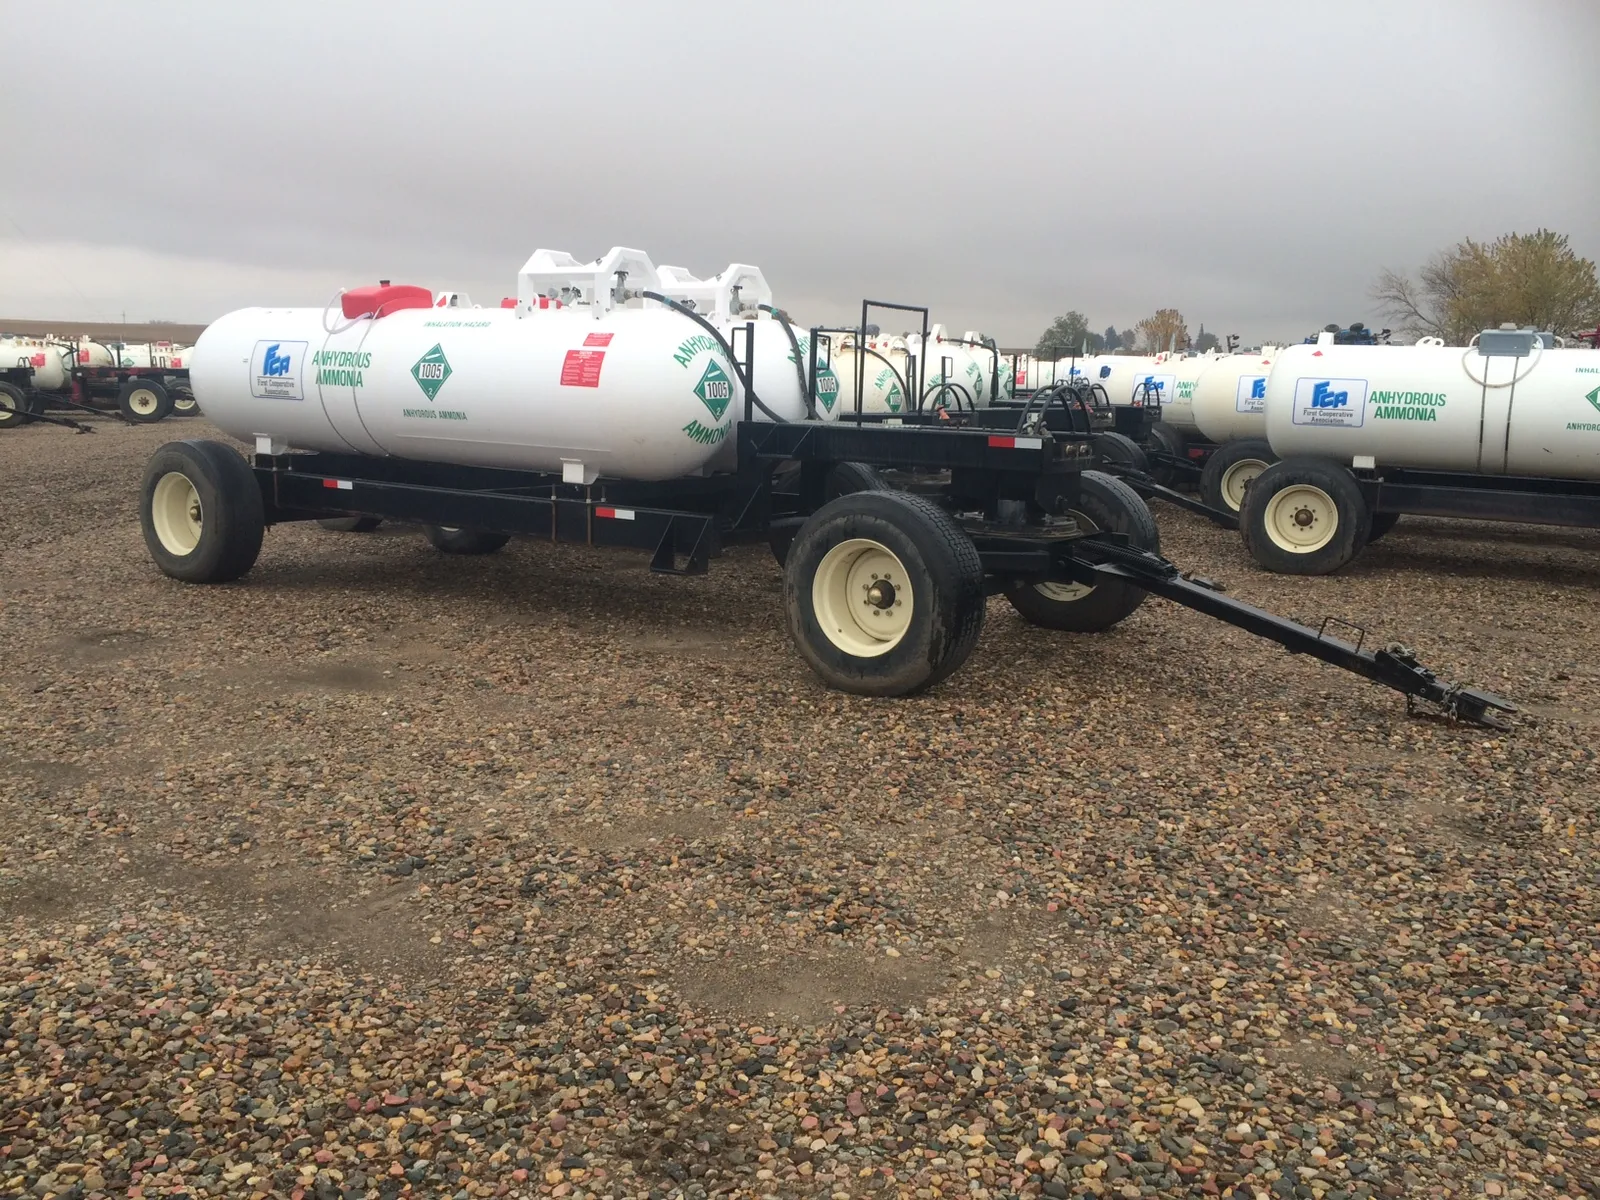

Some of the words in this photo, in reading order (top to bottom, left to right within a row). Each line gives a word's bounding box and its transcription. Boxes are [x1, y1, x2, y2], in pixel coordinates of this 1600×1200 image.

[263, 343, 291, 376] FCA
[312, 350, 372, 369] ANHYDROUS
[422, 363, 442, 378] 1005
[315, 369, 364, 388] AMMONIA
[707, 382, 728, 398] 1005
[1312, 381, 1348, 408] FCA
[1369, 391, 1447, 406] ANHYDROUS
[403, 409, 437, 419] ANHYDROUS
[439, 411, 468, 421] AMMONIA
[1319, 410, 1353, 418] Cooperative
[1374, 406, 1437, 421] AMMONIA
